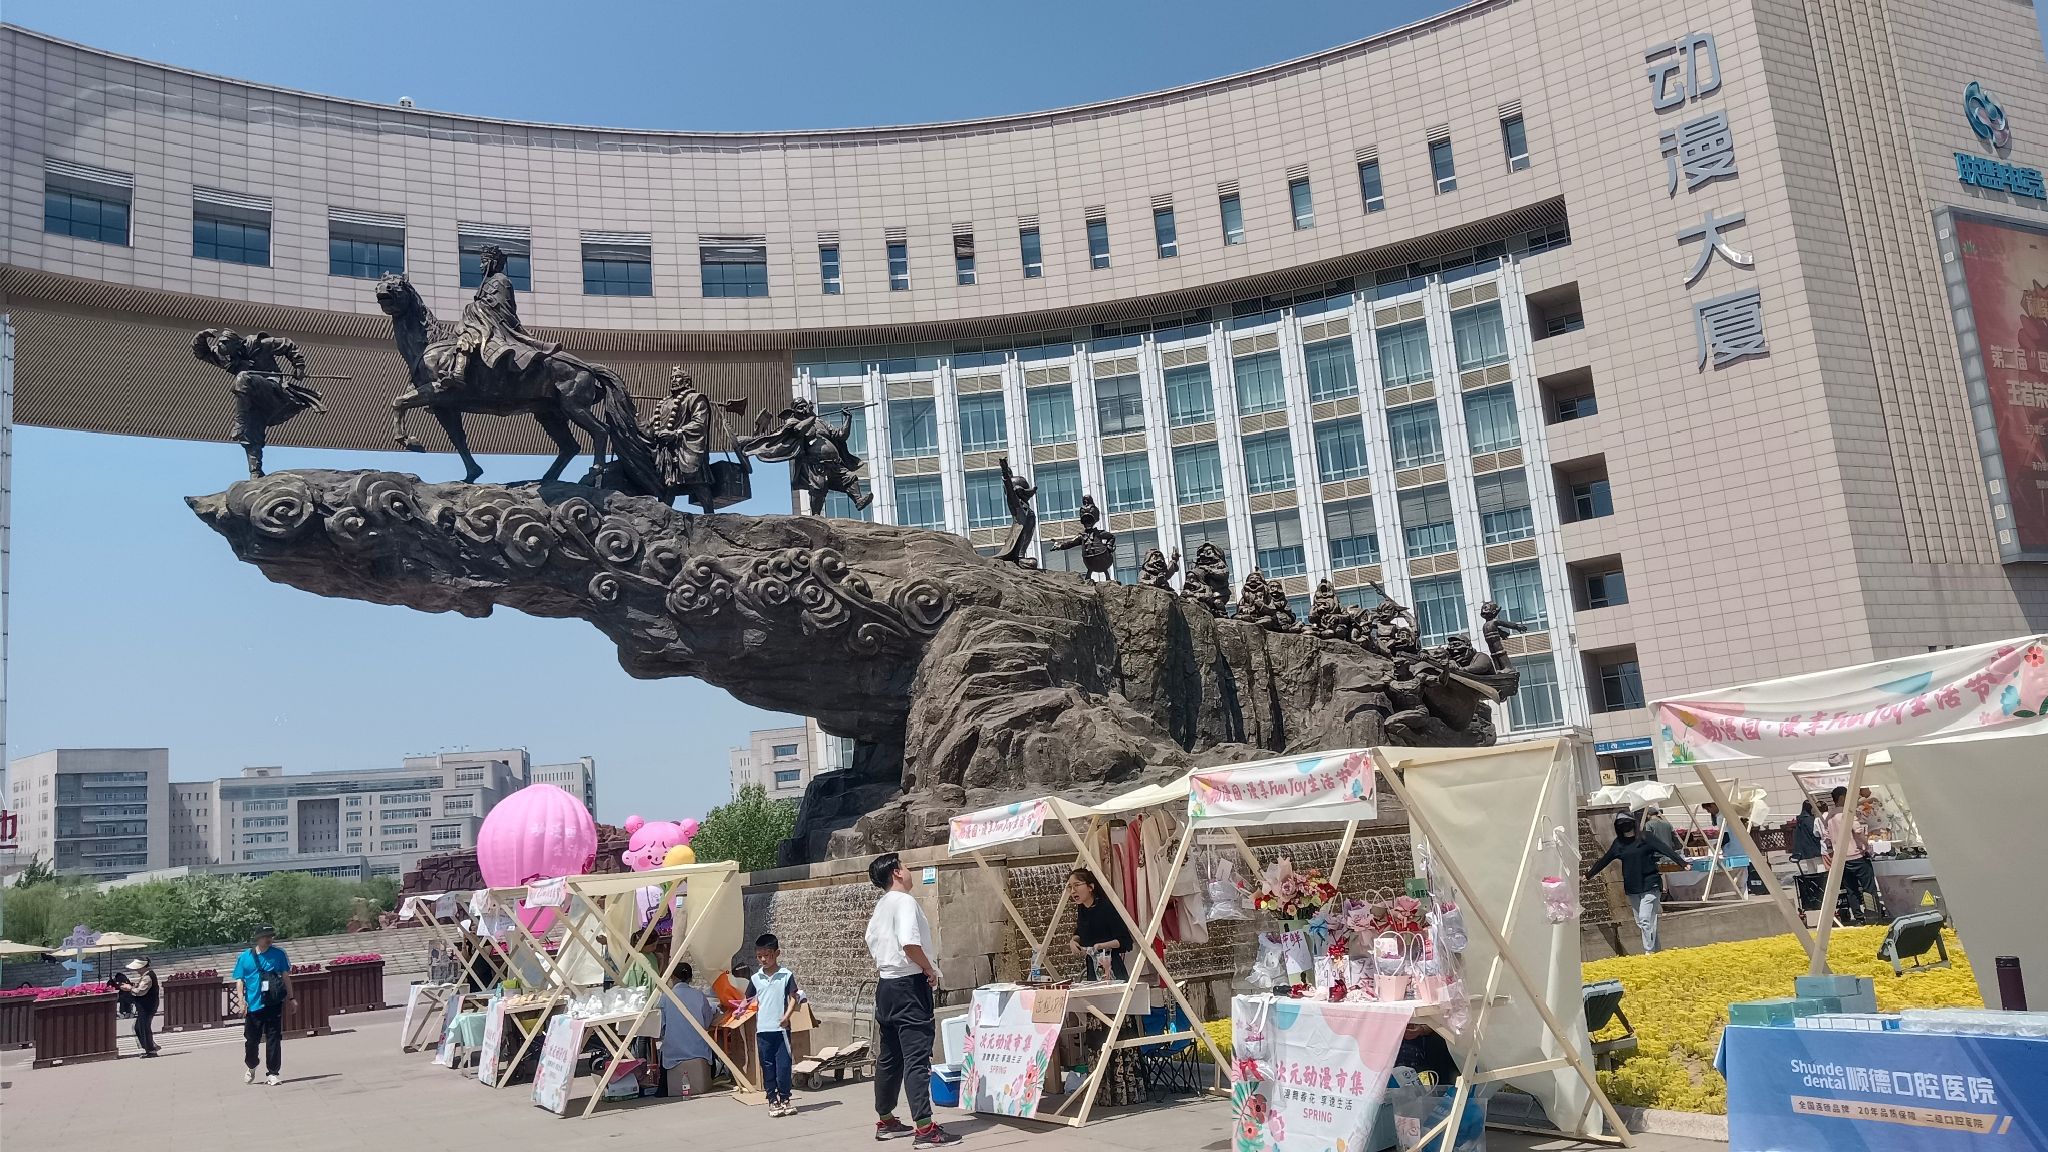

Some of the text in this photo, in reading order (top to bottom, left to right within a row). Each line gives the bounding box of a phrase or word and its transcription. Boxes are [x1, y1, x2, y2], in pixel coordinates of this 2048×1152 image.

[1644, 31, 1770, 374] 动漫大厦
[1791, 1059, 1843, 1077] Shunde
[1803, 1074, 1847, 1090] dental
[1846, 1066, 1998, 1105] 顺德口腔医院
[1303, 1107, 1333, 1123] SPRING
[1798, 1101, 1984, 1129] 全国连锁品牌 20年品质保障 二级口腔医院
